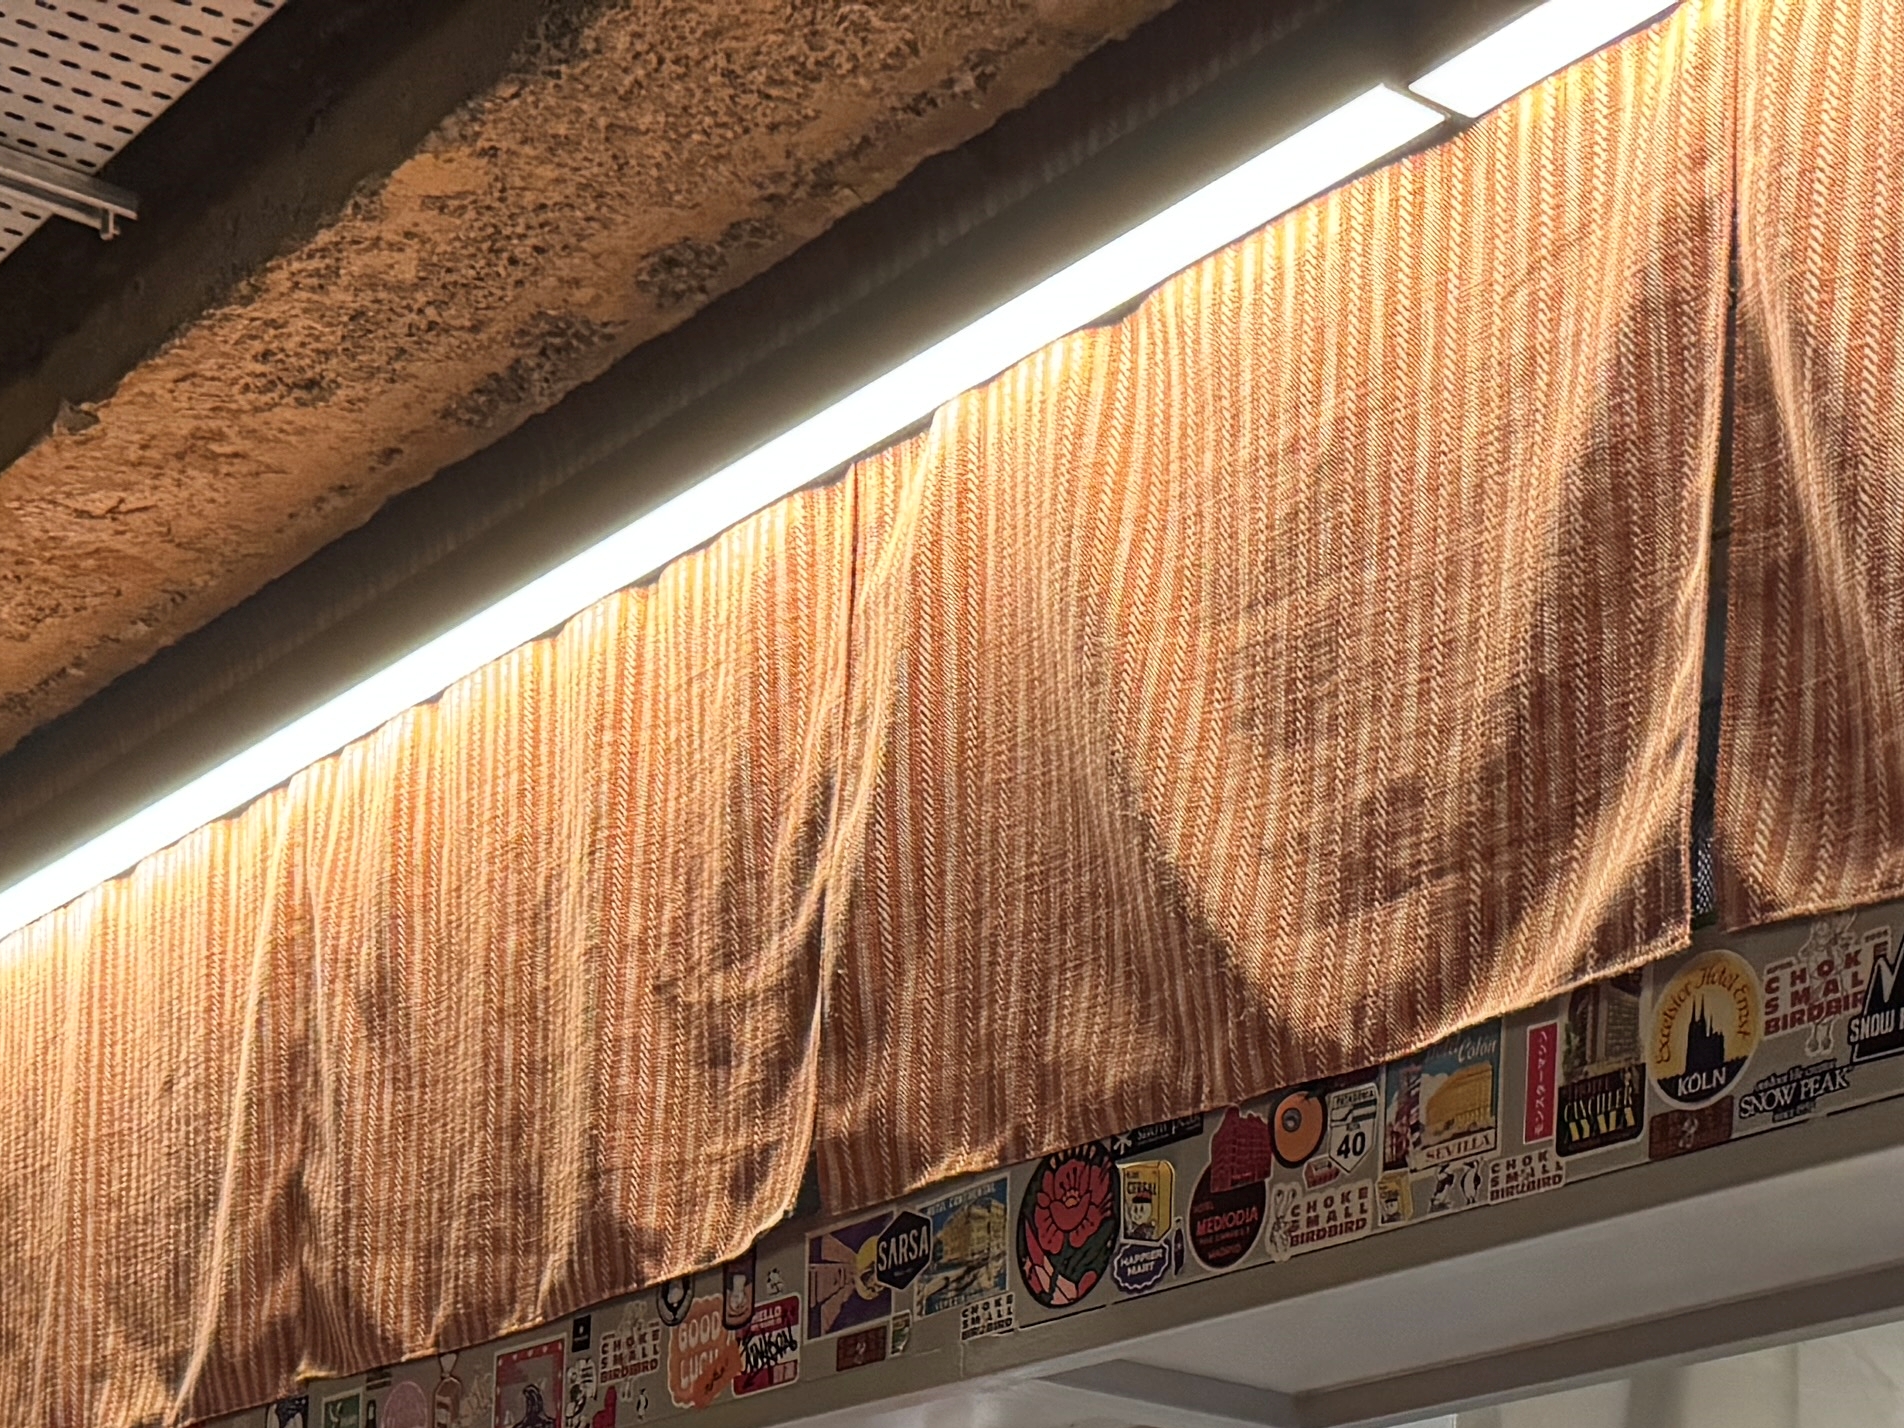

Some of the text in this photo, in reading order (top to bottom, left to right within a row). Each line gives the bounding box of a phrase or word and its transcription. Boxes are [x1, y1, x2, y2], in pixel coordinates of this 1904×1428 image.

[1764, 990, 1865, 1036] BIRDBIR
[1765, 971, 1864, 1015] SMAL
[1850, 1009, 1895, 1043] SNOW
[1740, 1083, 1796, 1118] SNOW
[1800, 1068, 1848, 1100] PEAK
[1337, 1132, 1366, 1159] 40
[1491, 1150, 1548, 1174] CHOK
[878, 1226, 928, 1272] SARSA
[678, 1311, 721, 1352] GOOD
